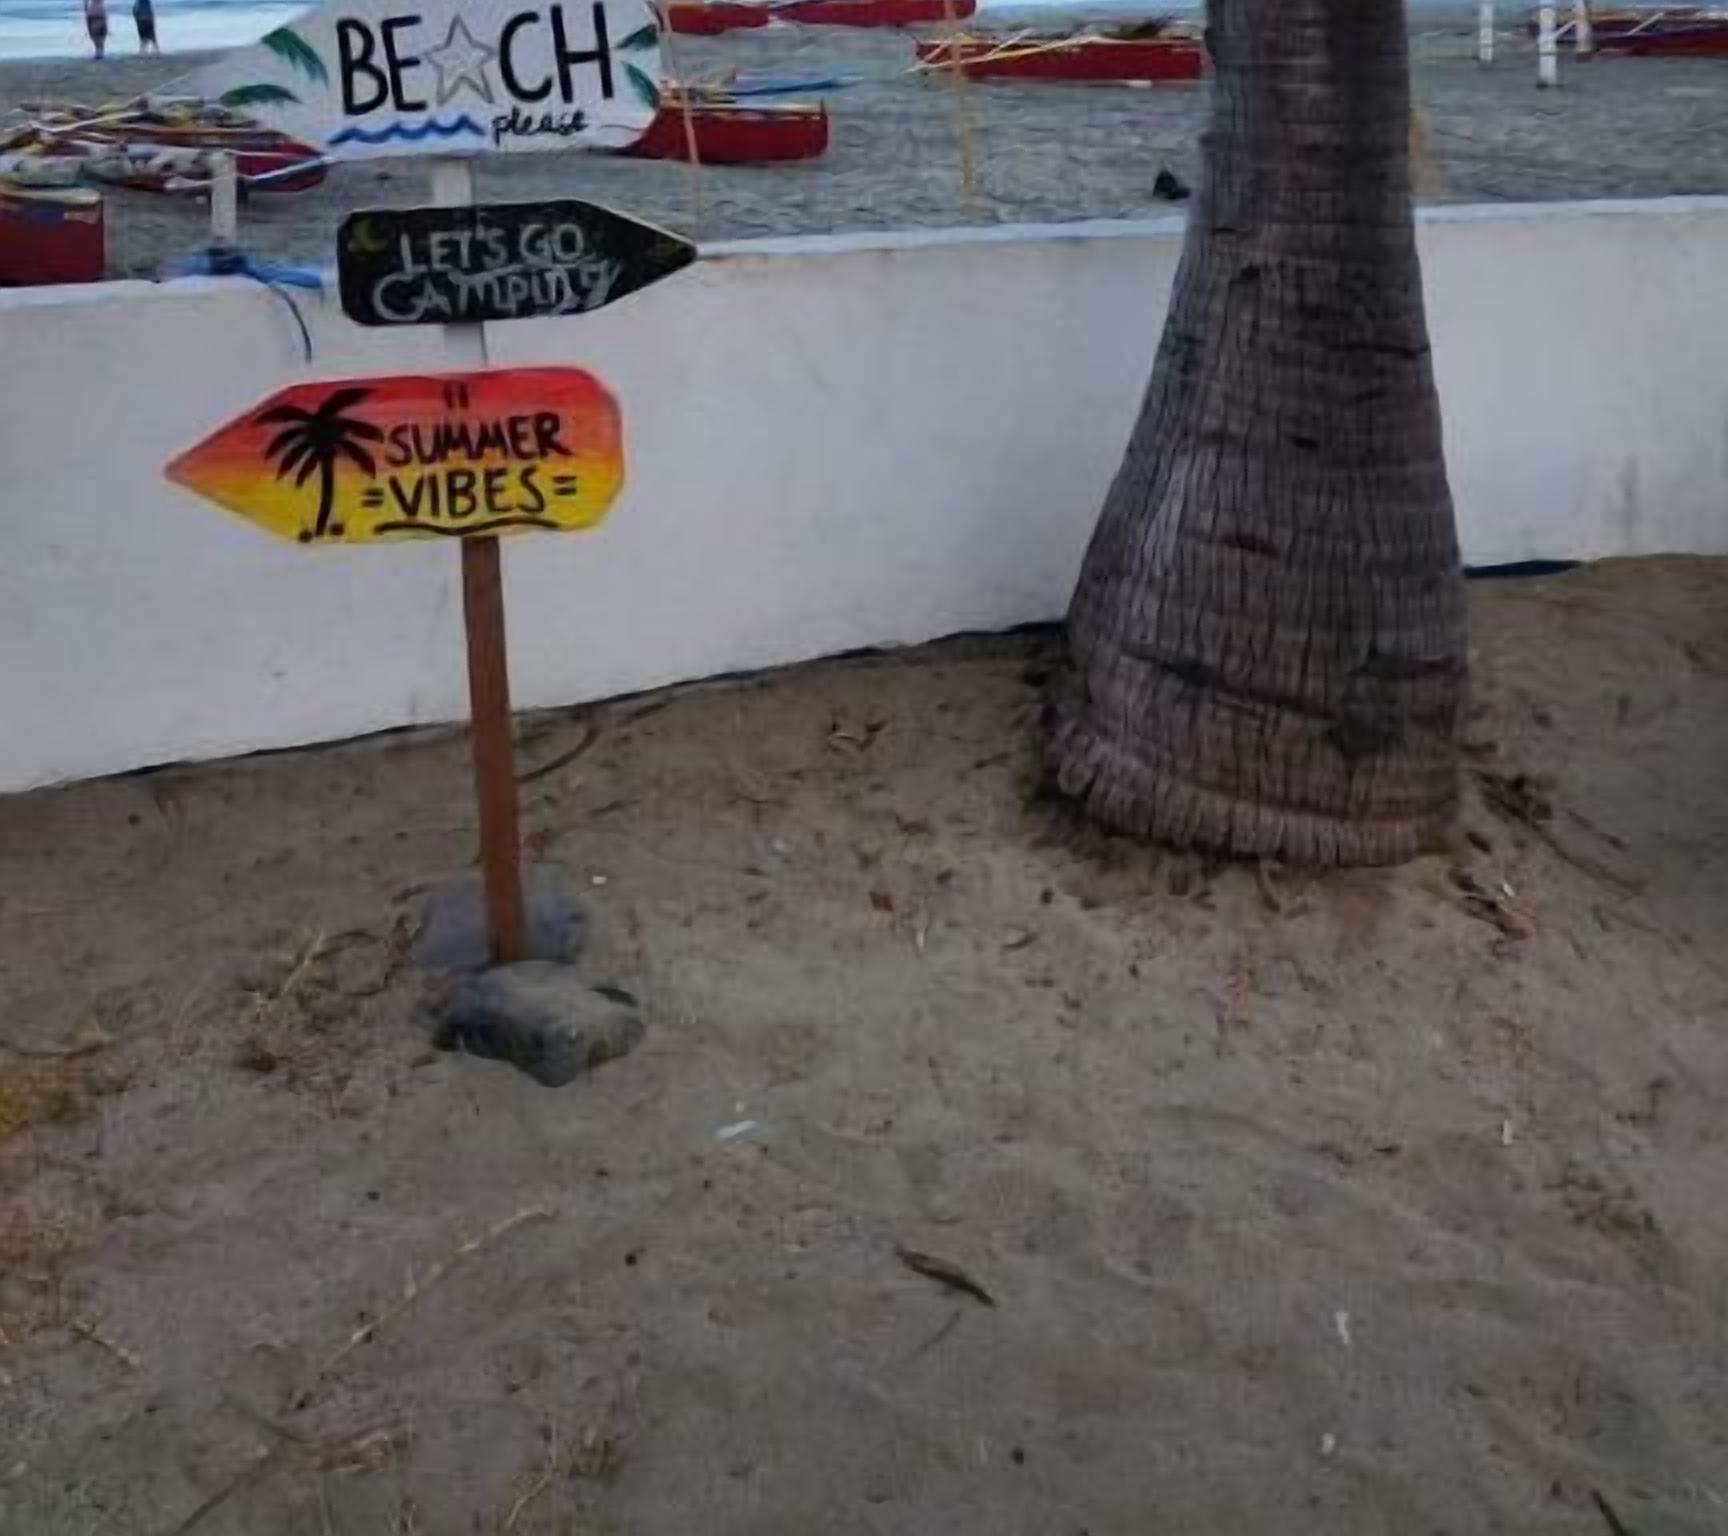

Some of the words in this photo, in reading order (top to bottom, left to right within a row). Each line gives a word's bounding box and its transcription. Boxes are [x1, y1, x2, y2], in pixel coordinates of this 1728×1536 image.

[491, 105, 588, 144] please
[401, 221, 508, 273] LET'S
[519, 222, 586, 267] GO
[385, 412, 578, 466] SUMMER
[388, 466, 546, 519] VIBES
